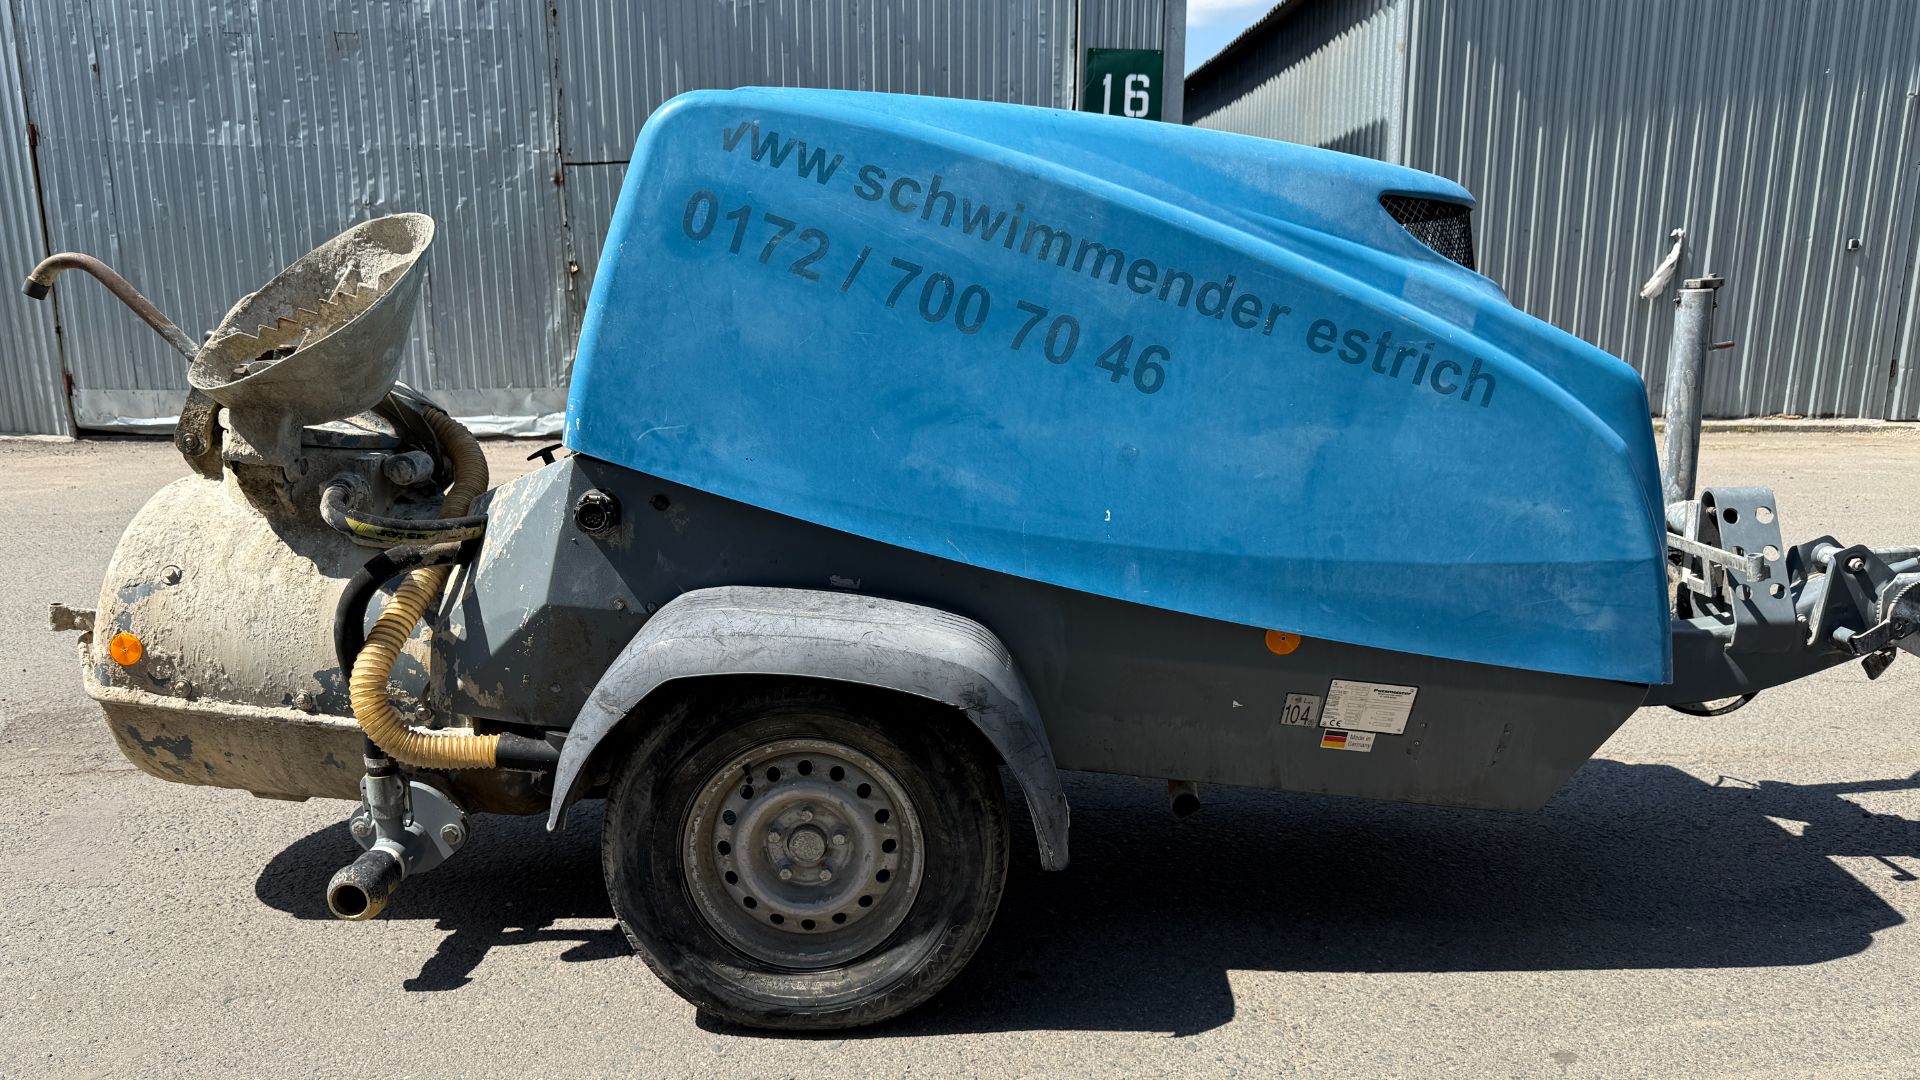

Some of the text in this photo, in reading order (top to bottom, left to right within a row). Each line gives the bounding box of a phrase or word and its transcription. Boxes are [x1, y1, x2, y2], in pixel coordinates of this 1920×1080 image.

[1102, 73, 1150, 118] 16
[683, 190, 1172, 395] 0172 / 700 70 46
[853, 165, 1292, 337] schwimmender
[1306, 317, 1497, 408] estrich
[1285, 703, 1311, 726] 104
